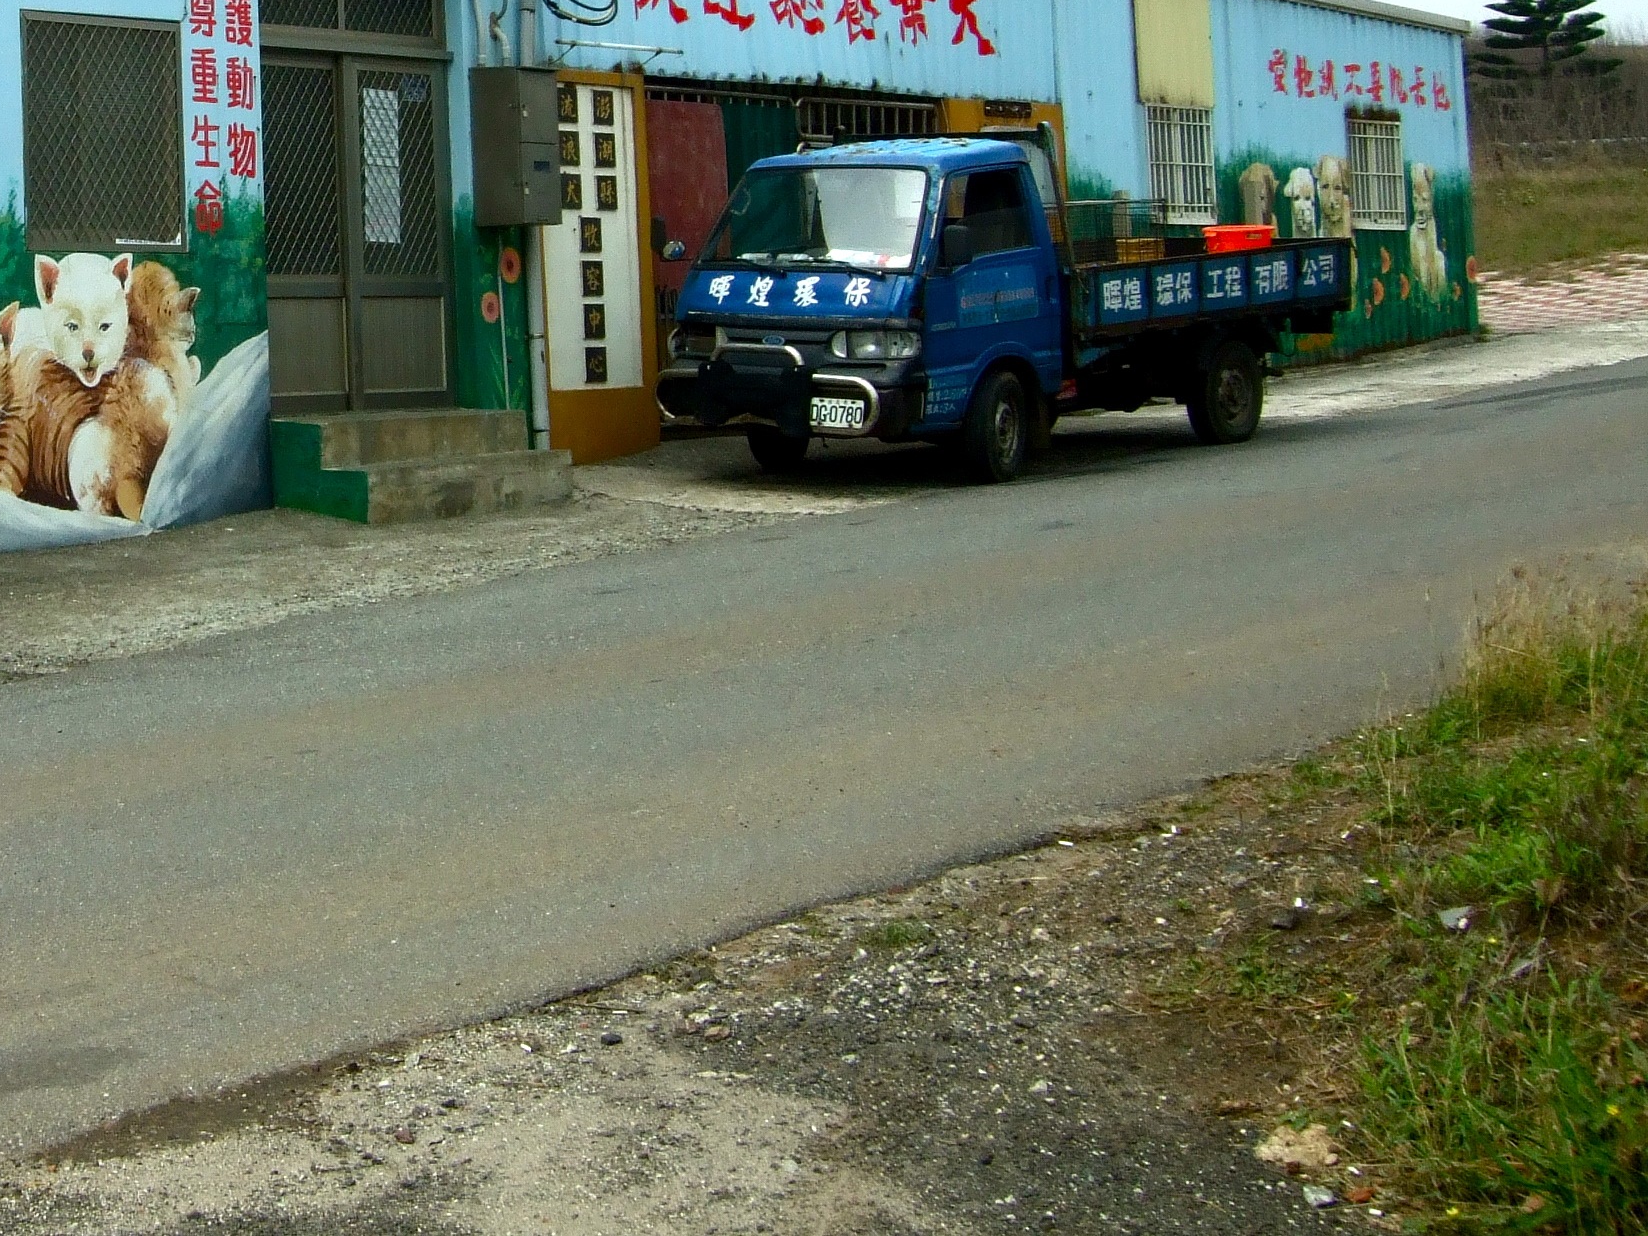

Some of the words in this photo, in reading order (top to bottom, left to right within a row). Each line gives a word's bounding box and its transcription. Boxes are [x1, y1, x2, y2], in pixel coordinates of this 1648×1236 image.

[560, 92, 579, 204] 流浪犬
[595, 93, 616, 205] 澎湖縣
[583, 222, 604, 374] 收容中心
